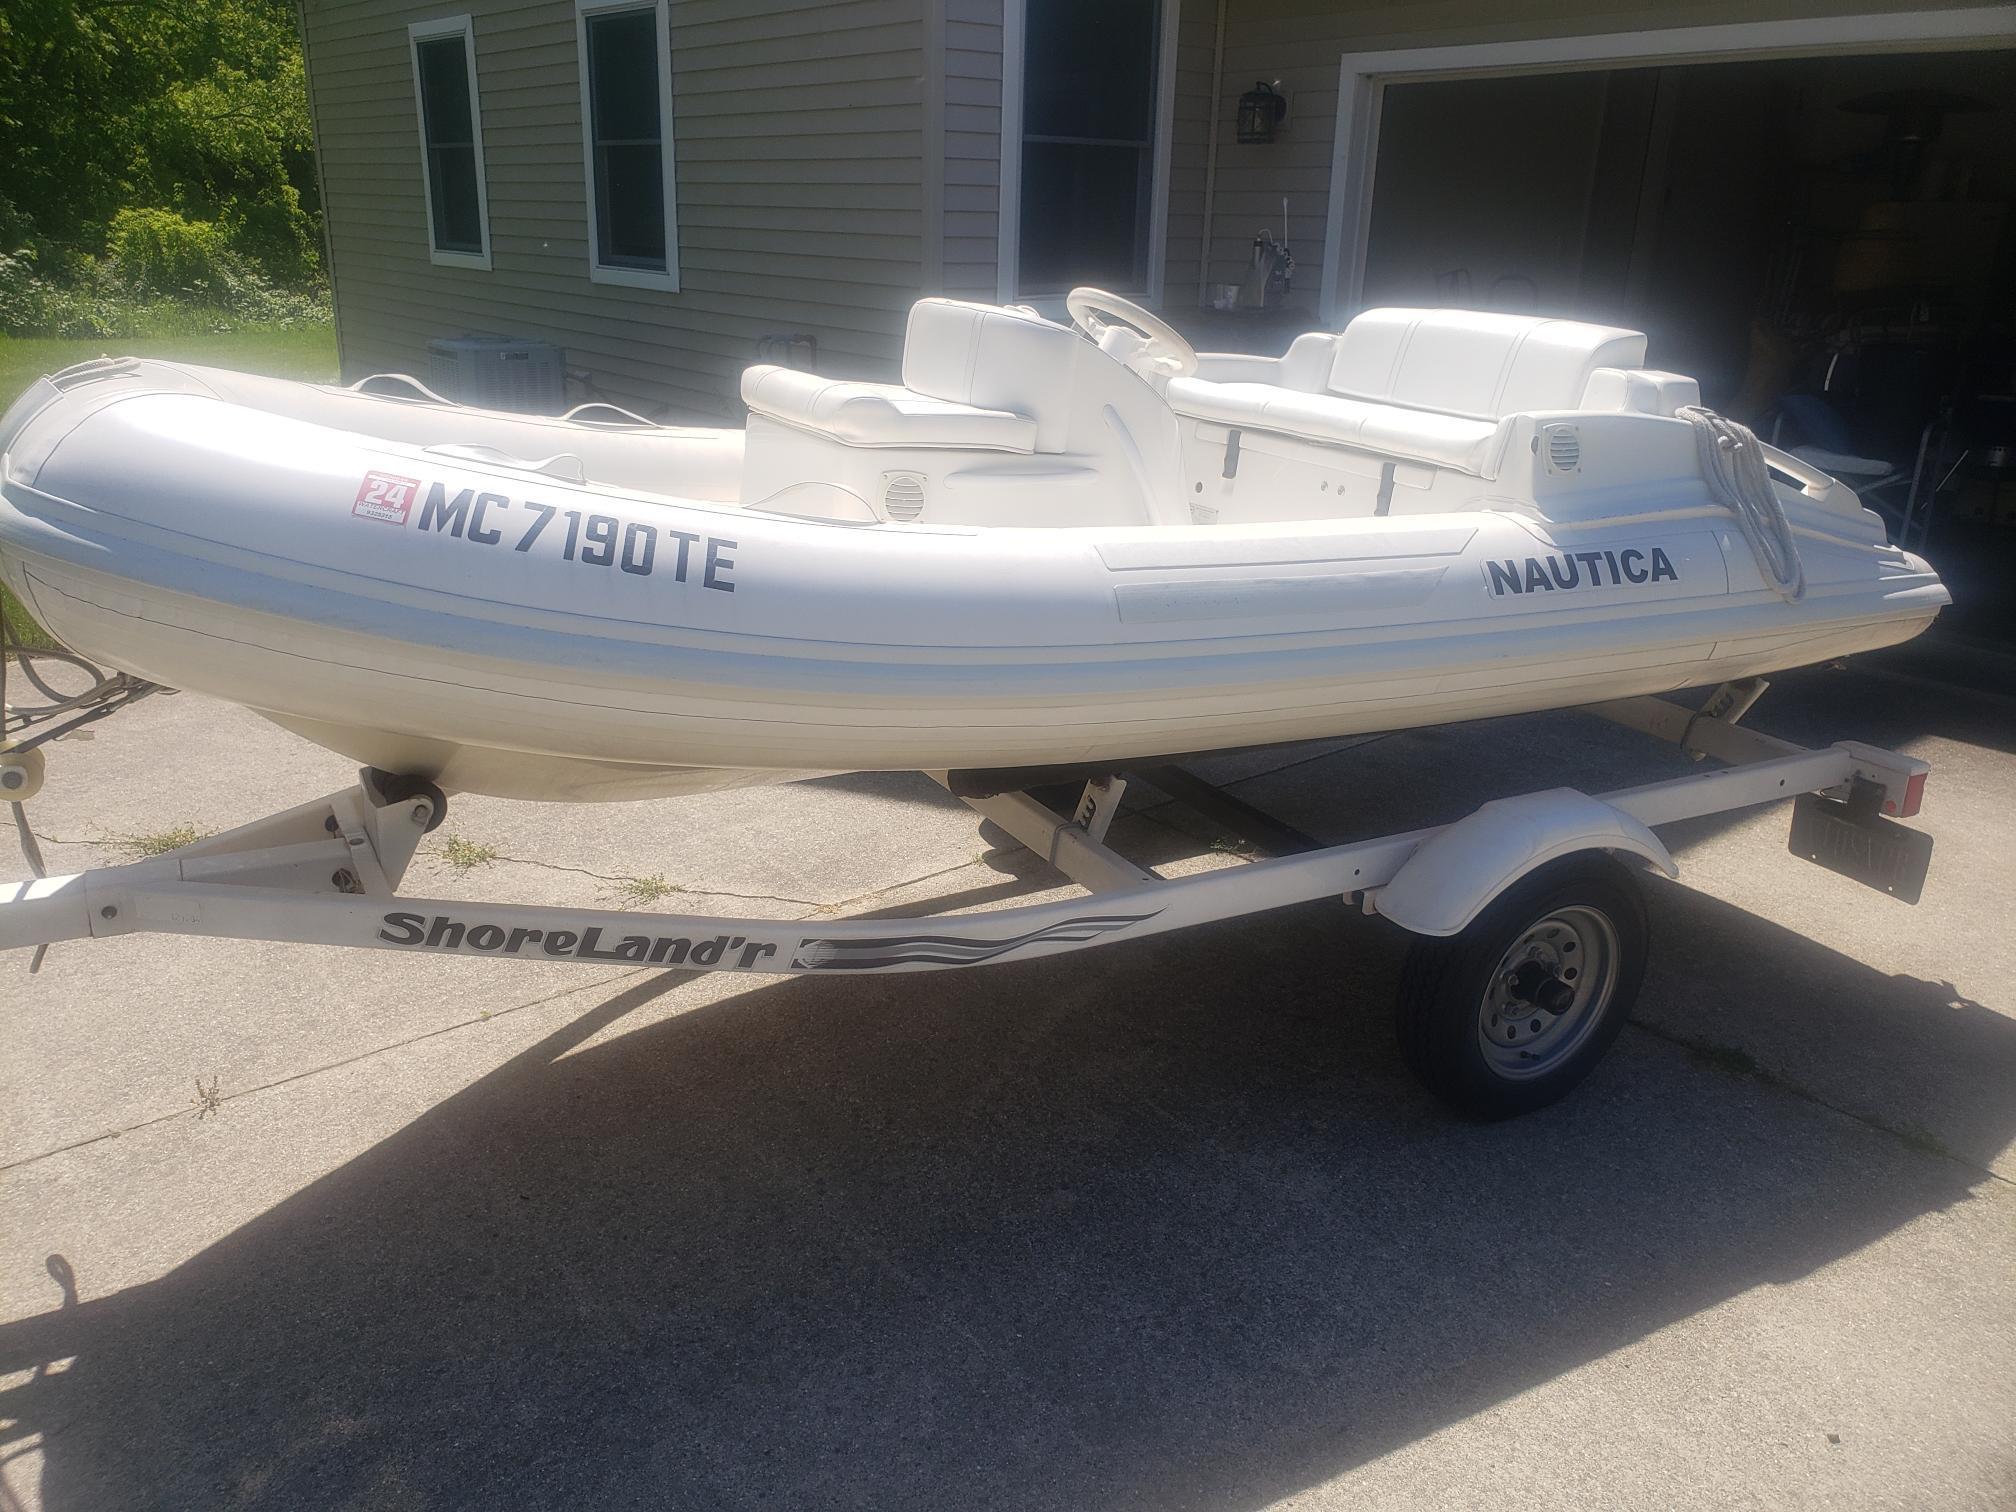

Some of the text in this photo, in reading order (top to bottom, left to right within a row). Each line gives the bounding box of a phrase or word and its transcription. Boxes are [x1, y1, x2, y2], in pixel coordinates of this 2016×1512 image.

[364, 479, 407, 509] 24
[418, 481, 739, 593] MC 7190 TE
[1486, 547, 1679, 596] NAUTICA
[378, 911, 778, 969] ShoreLand'r
